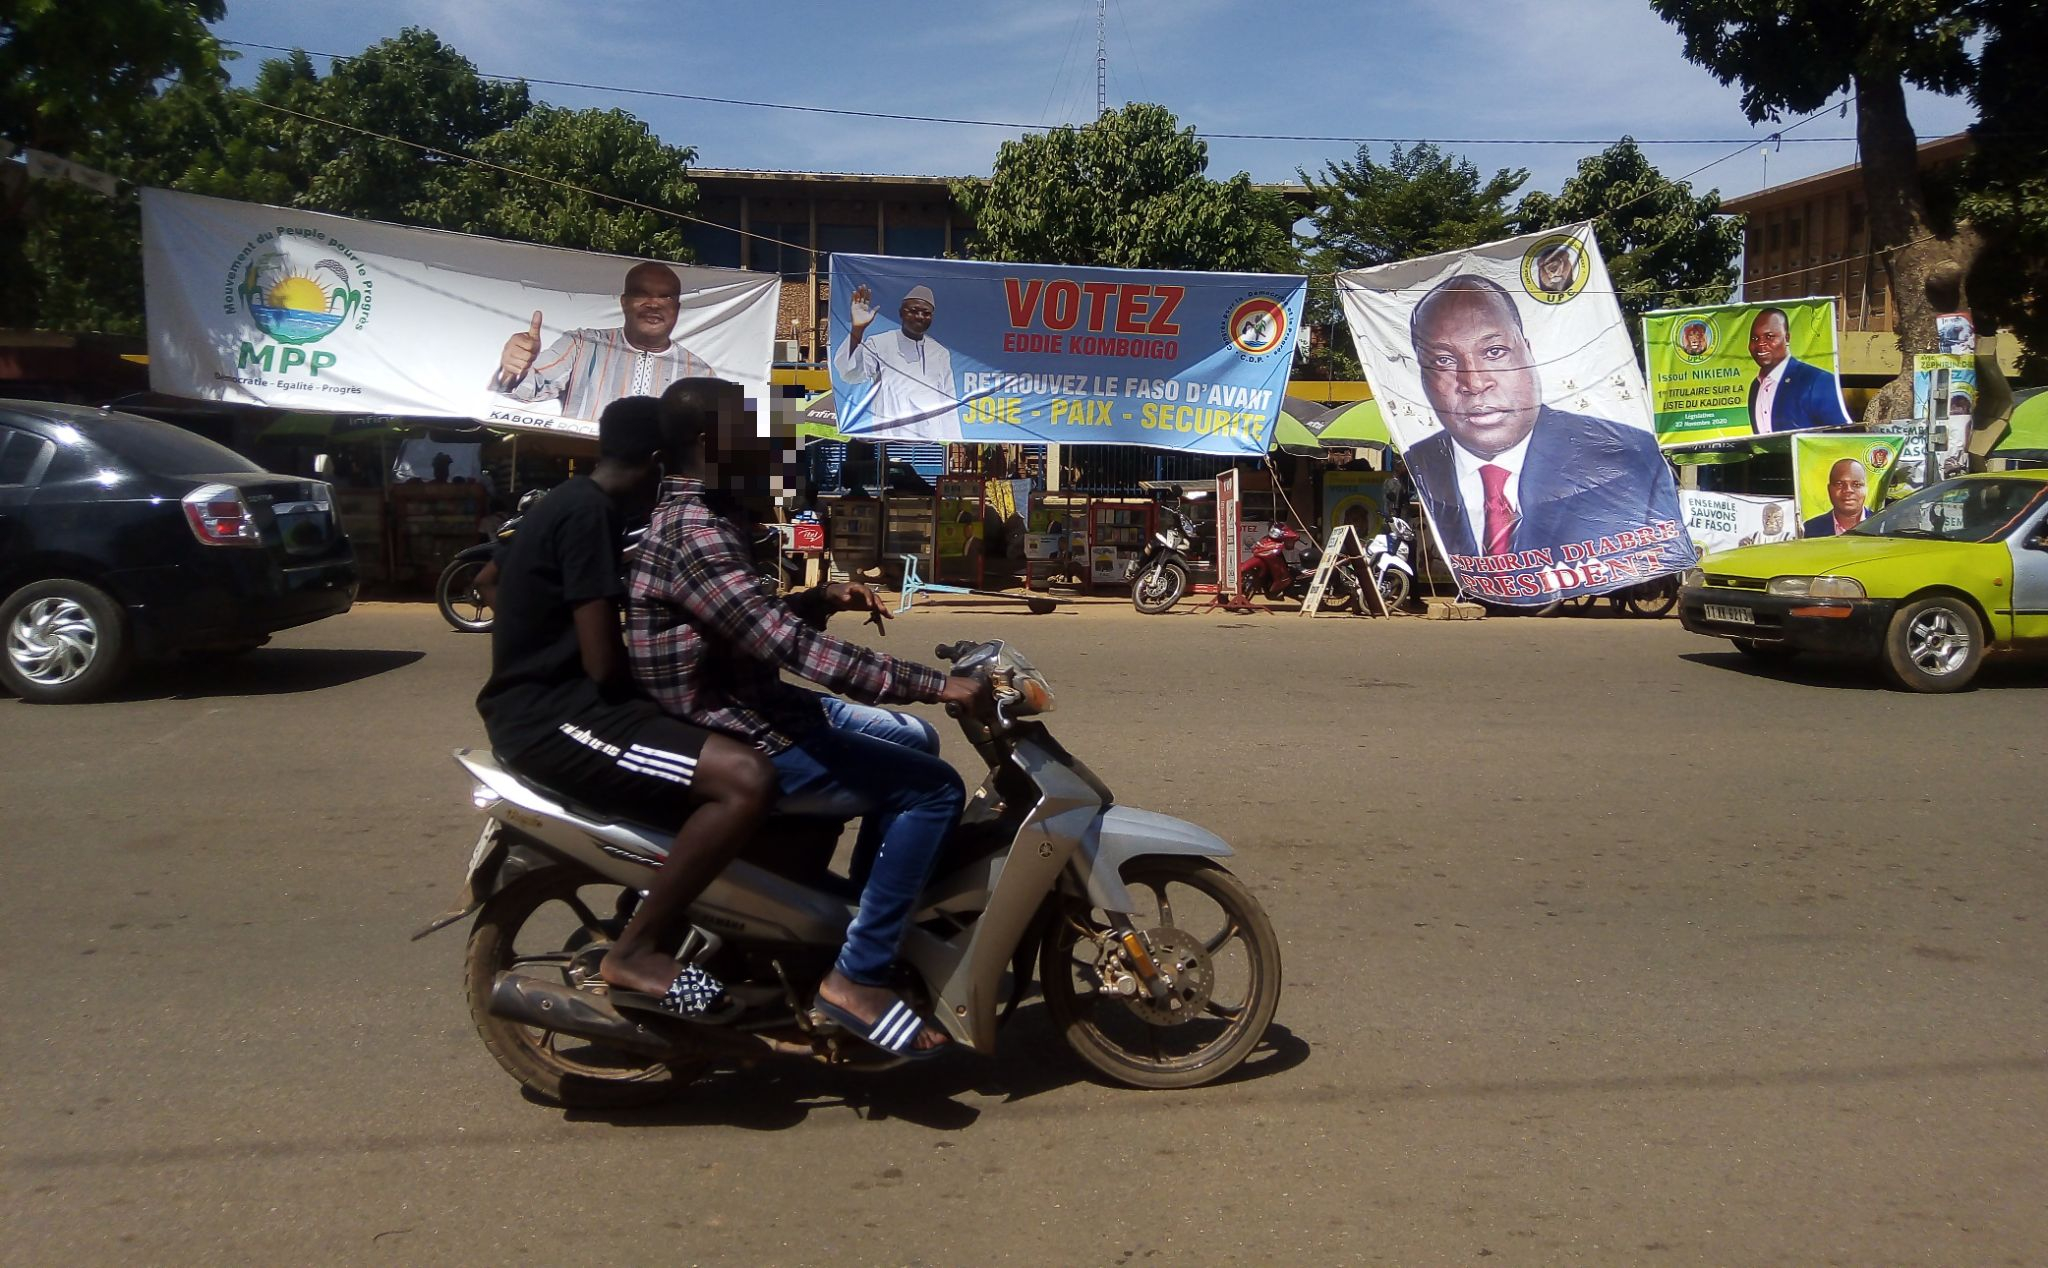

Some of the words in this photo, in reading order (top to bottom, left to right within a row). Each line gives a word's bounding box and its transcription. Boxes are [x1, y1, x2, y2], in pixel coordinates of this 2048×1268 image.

[257, 231, 274, 244] du
[276, 226, 326, 240] Peuple
[328, 238, 359, 262] pour
[224, 242, 256, 315] Mouvement
[355, 262, 367, 277] le
[355, 280, 373, 331] Progrès
[1004, 277, 1185, 336] VOTEZ
[1003, 333, 1062, 354] EDDIE
[1070, 335, 1179, 361] KOMBOIGO
[238, 340, 337, 377] MPP
[1240, 354, 1264, 363] C.D.P.
[1658, 371, 1688, 382] Issouf
[1692, 367, 1741, 380] NIKIEMA
[322, 383, 362, 395] Progrès
[963, 371, 1087, 396] RETROUVEZ
[1094, 375, 1118, 398] LE
[1125, 378, 1179, 400] FASO
[1186, 382, 1272, 410] D'AVANT
[1668, 387, 1711, 398] TITULAIRE
[1712, 385, 1730, 395] SUR
[1732, 384, 1744, 393] LA
[1663, 400, 1683, 410] LISTE
[1685, 399, 1697, 408] DU
[1700, 396, 1741, 407] KADIOGO
[490, 410, 554, 428] KABORÉ
[963, 396, 1022, 425] JOIE
[1051, 397, 1113, 427] PAIX
[1141, 401, 1267, 442] SECURITE
[1690, 507, 1736, 521] SAUVONS
[1690, 517, 1702, 528] LE
[1705, 519, 1731, 532] FASO
[1560, 520, 1681, 562] DIABRE
[1461, 547, 1665, 599] PRESIDENT
